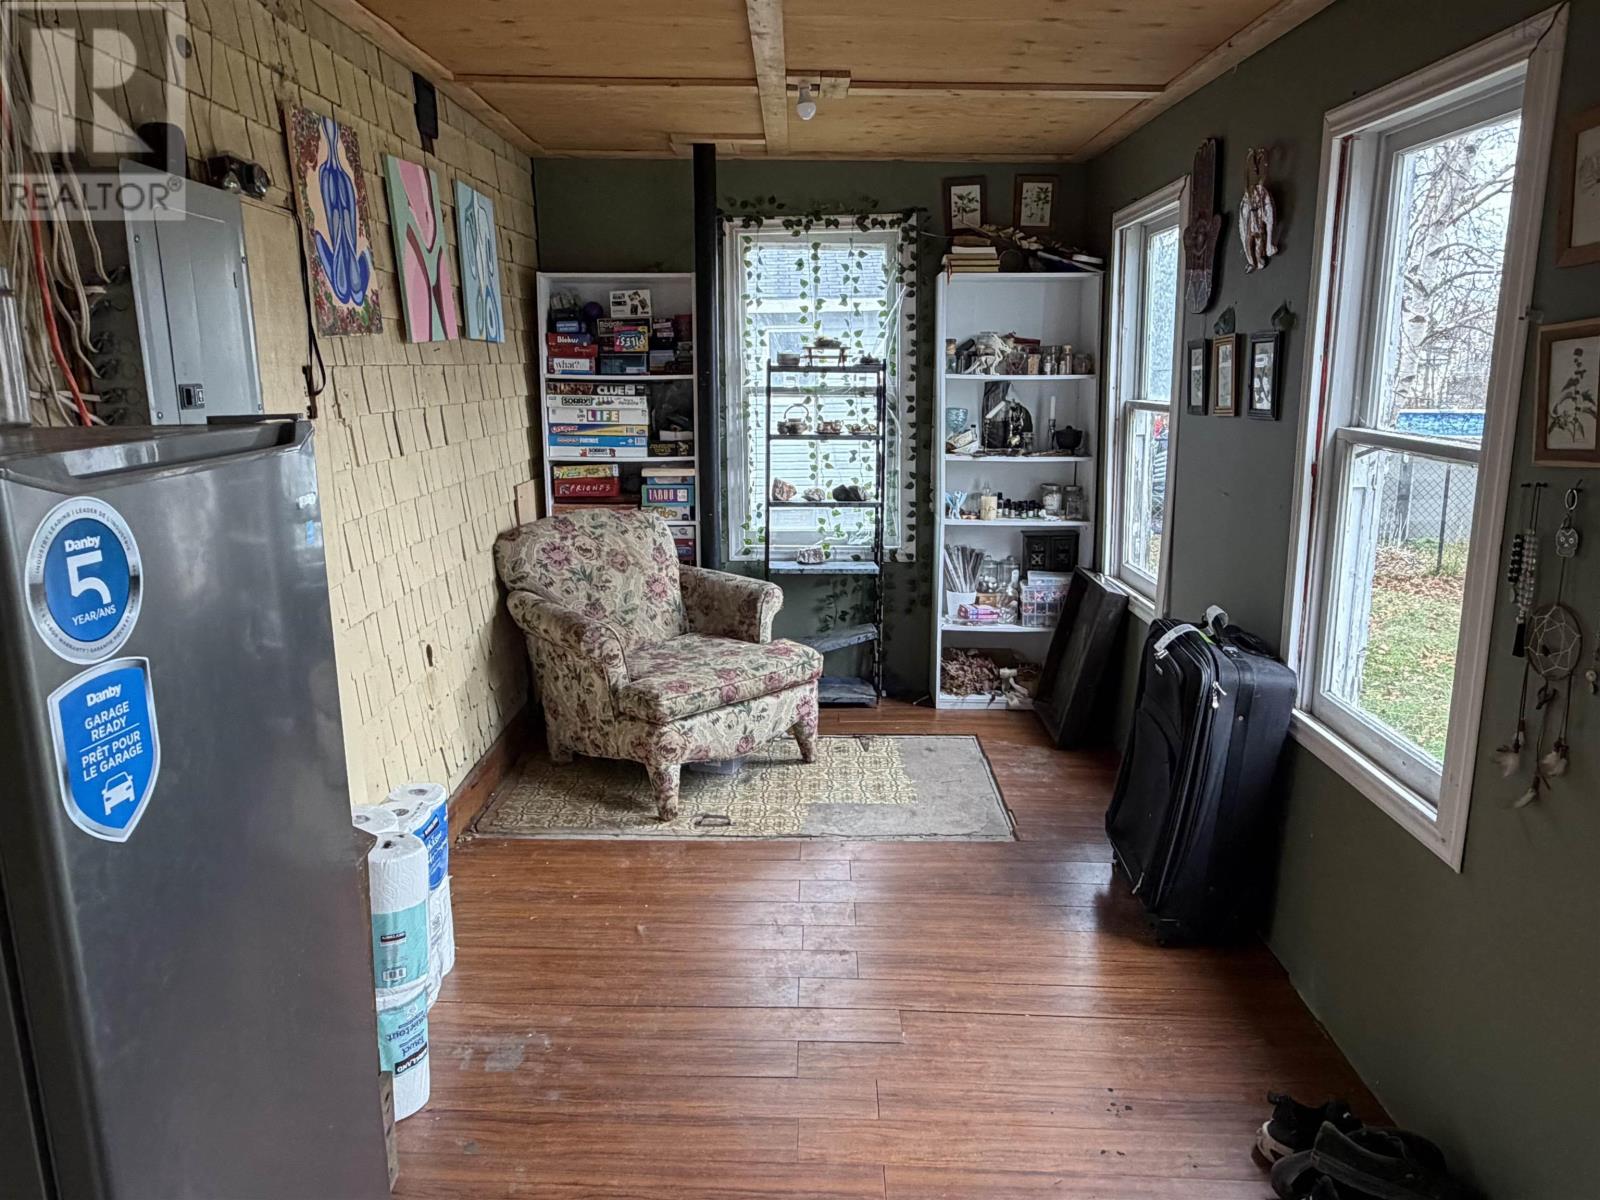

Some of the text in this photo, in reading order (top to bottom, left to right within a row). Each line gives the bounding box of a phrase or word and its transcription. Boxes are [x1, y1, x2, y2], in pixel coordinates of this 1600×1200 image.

[597, 385, 625, 396] CLUE
[587, 409, 619, 423] LIFE
[64, 535, 101, 553] Danby
[66, 549, 112, 606] 5
[71, 603, 117, 627] YEAR/ANS
[86, 683, 123, 707] Danby
[84, 700, 131, 730] GARAGE
[91, 716, 128, 742] READY
[81, 730, 142, 768] PRÊT POUR
[83, 742, 144, 782] LE GARAGE
